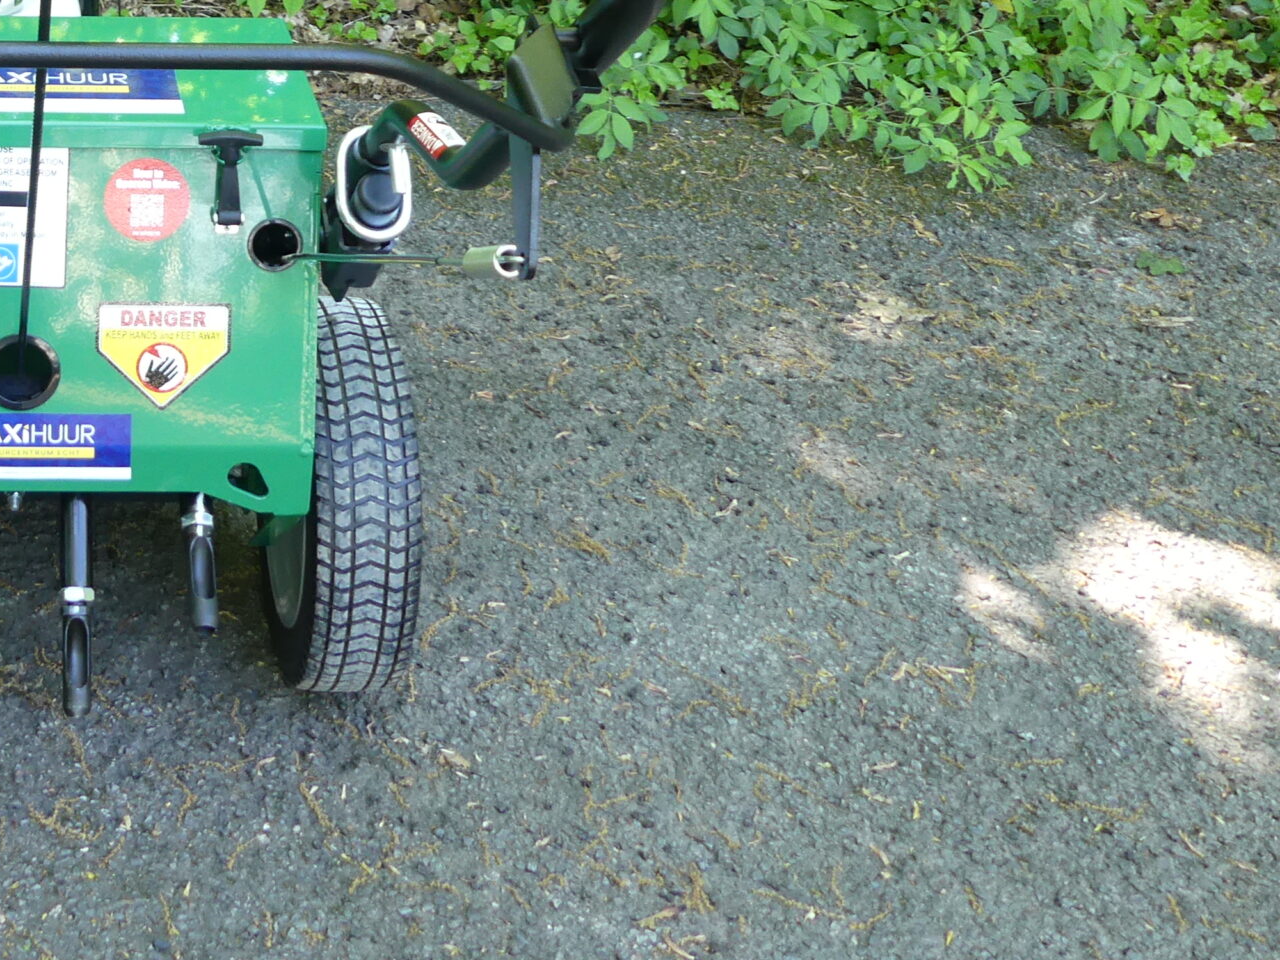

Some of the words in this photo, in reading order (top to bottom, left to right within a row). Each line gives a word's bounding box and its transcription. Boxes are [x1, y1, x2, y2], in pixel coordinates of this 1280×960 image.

[3, 156, 13, 165] OF
[17, 156, 64, 166] OPATION
[38, 169, 57, 177] ROM
[120, 309, 207, 328] DANGER
[105, 330, 128, 339] KEEP
[129, 330, 157, 340] HANDS
[175, 331, 196, 341] FEET
[198, 332, 221, 341] AWAY
